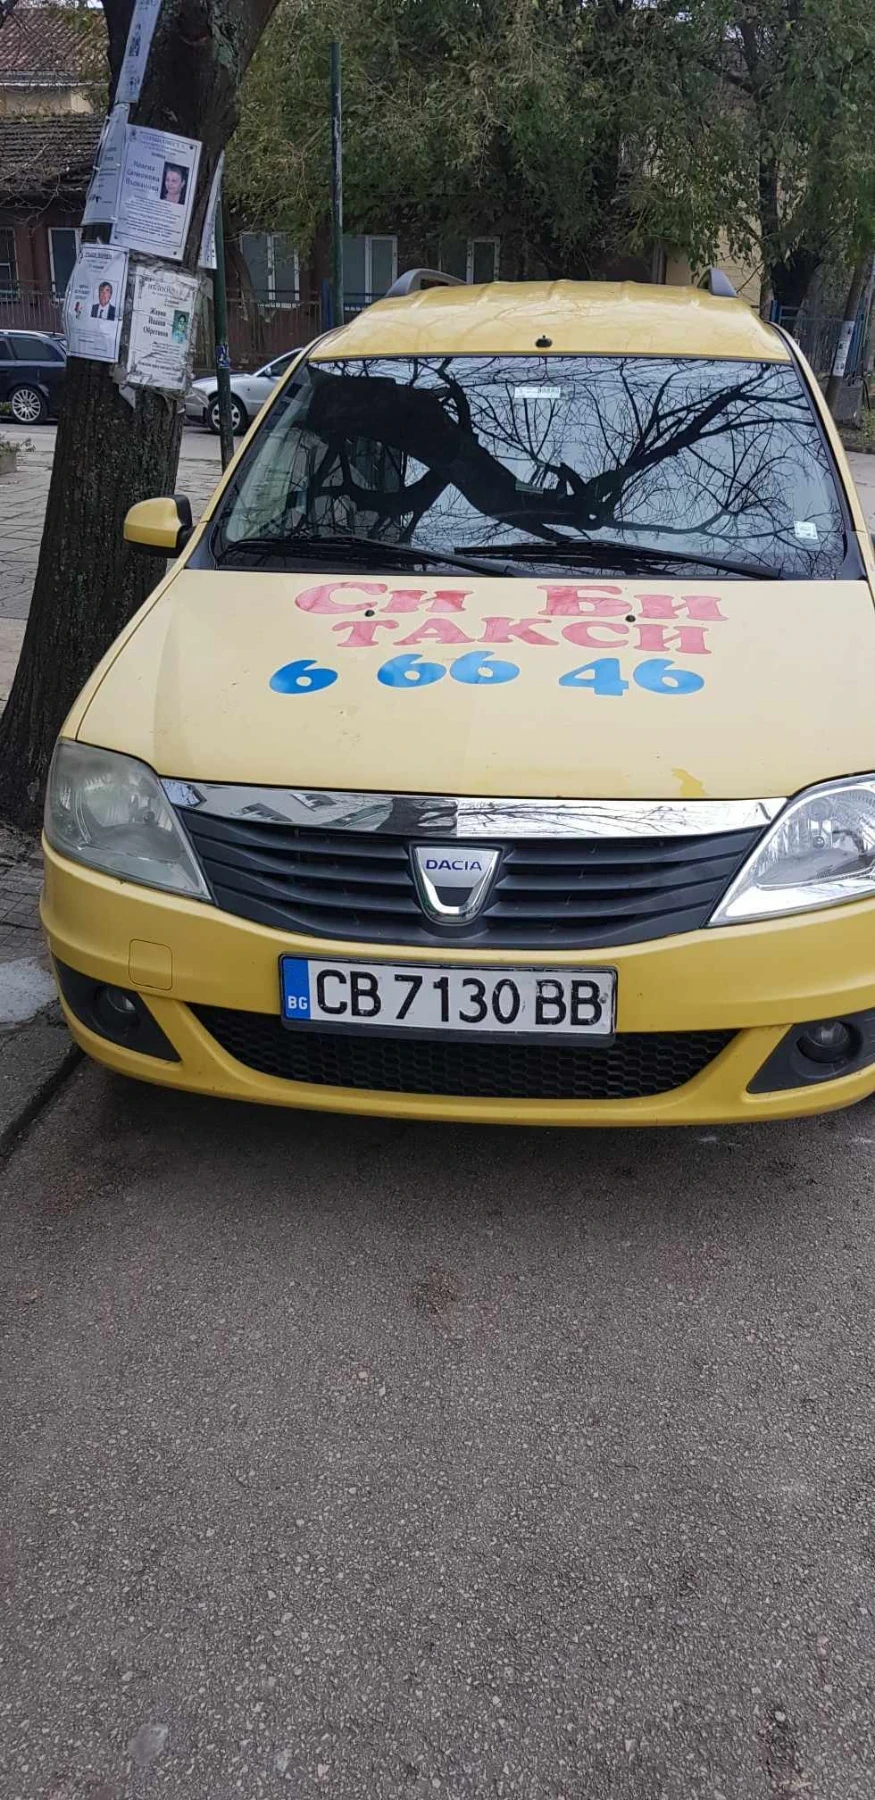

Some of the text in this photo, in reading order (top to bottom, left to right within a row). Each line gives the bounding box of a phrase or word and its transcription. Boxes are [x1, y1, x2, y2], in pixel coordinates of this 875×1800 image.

[331, 617, 713, 655] ТАКСИ
[269, 650, 705, 697] 6 66 46
[425, 858, 483, 872] DACIA
[287, 995, 308, 1010] BG
[316, 968, 604, 1027] CB 7130 BB
